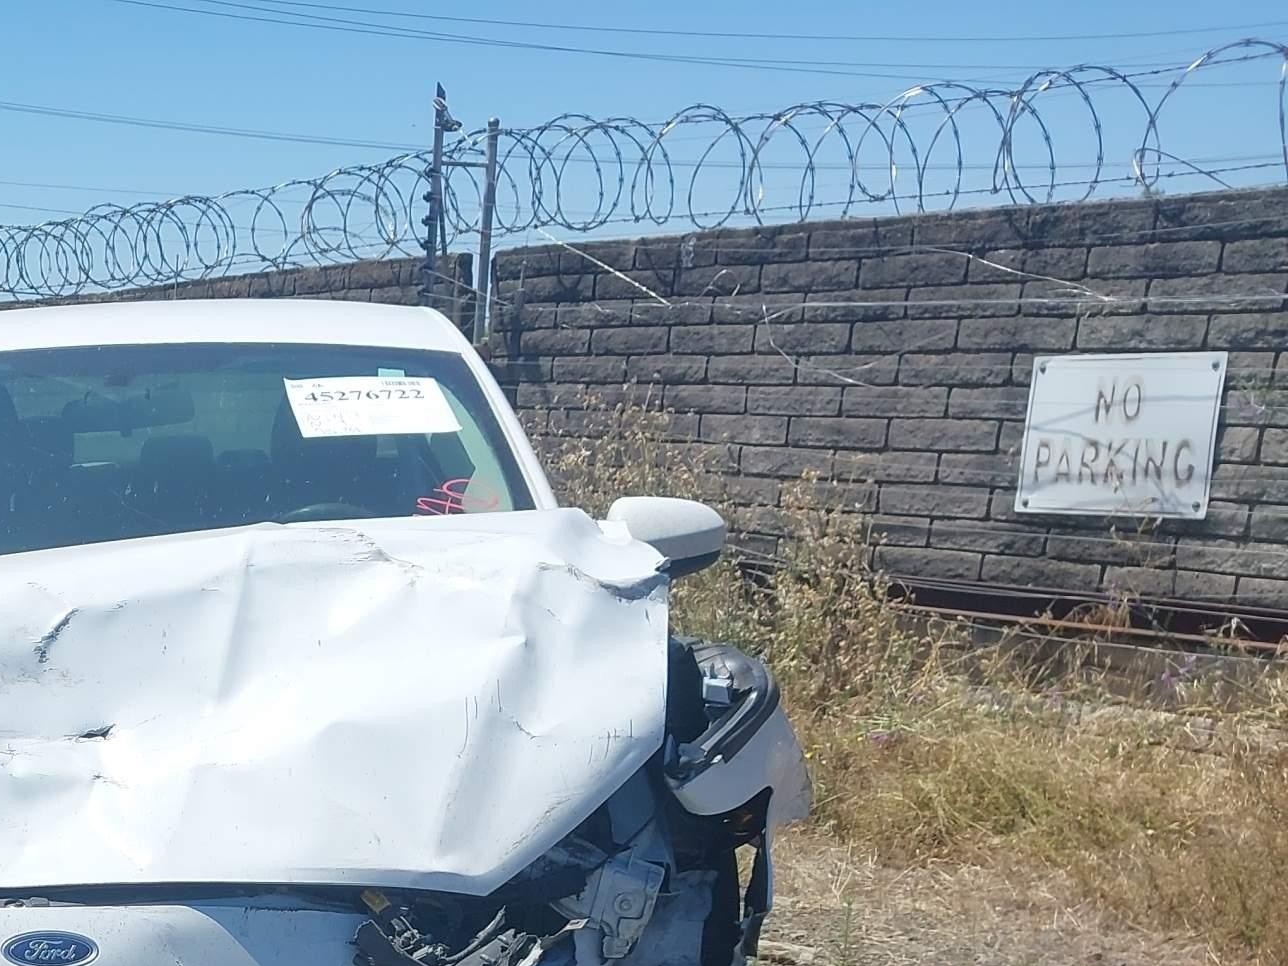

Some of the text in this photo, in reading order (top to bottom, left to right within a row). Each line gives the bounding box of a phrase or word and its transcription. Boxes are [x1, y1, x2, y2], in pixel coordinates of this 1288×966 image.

[306, 389, 425, 402] 45276722
[1094, 382, 1142, 423] NO
[1032, 440, 1195, 487] PARKING
[24, 939, 77, 961] Ford
